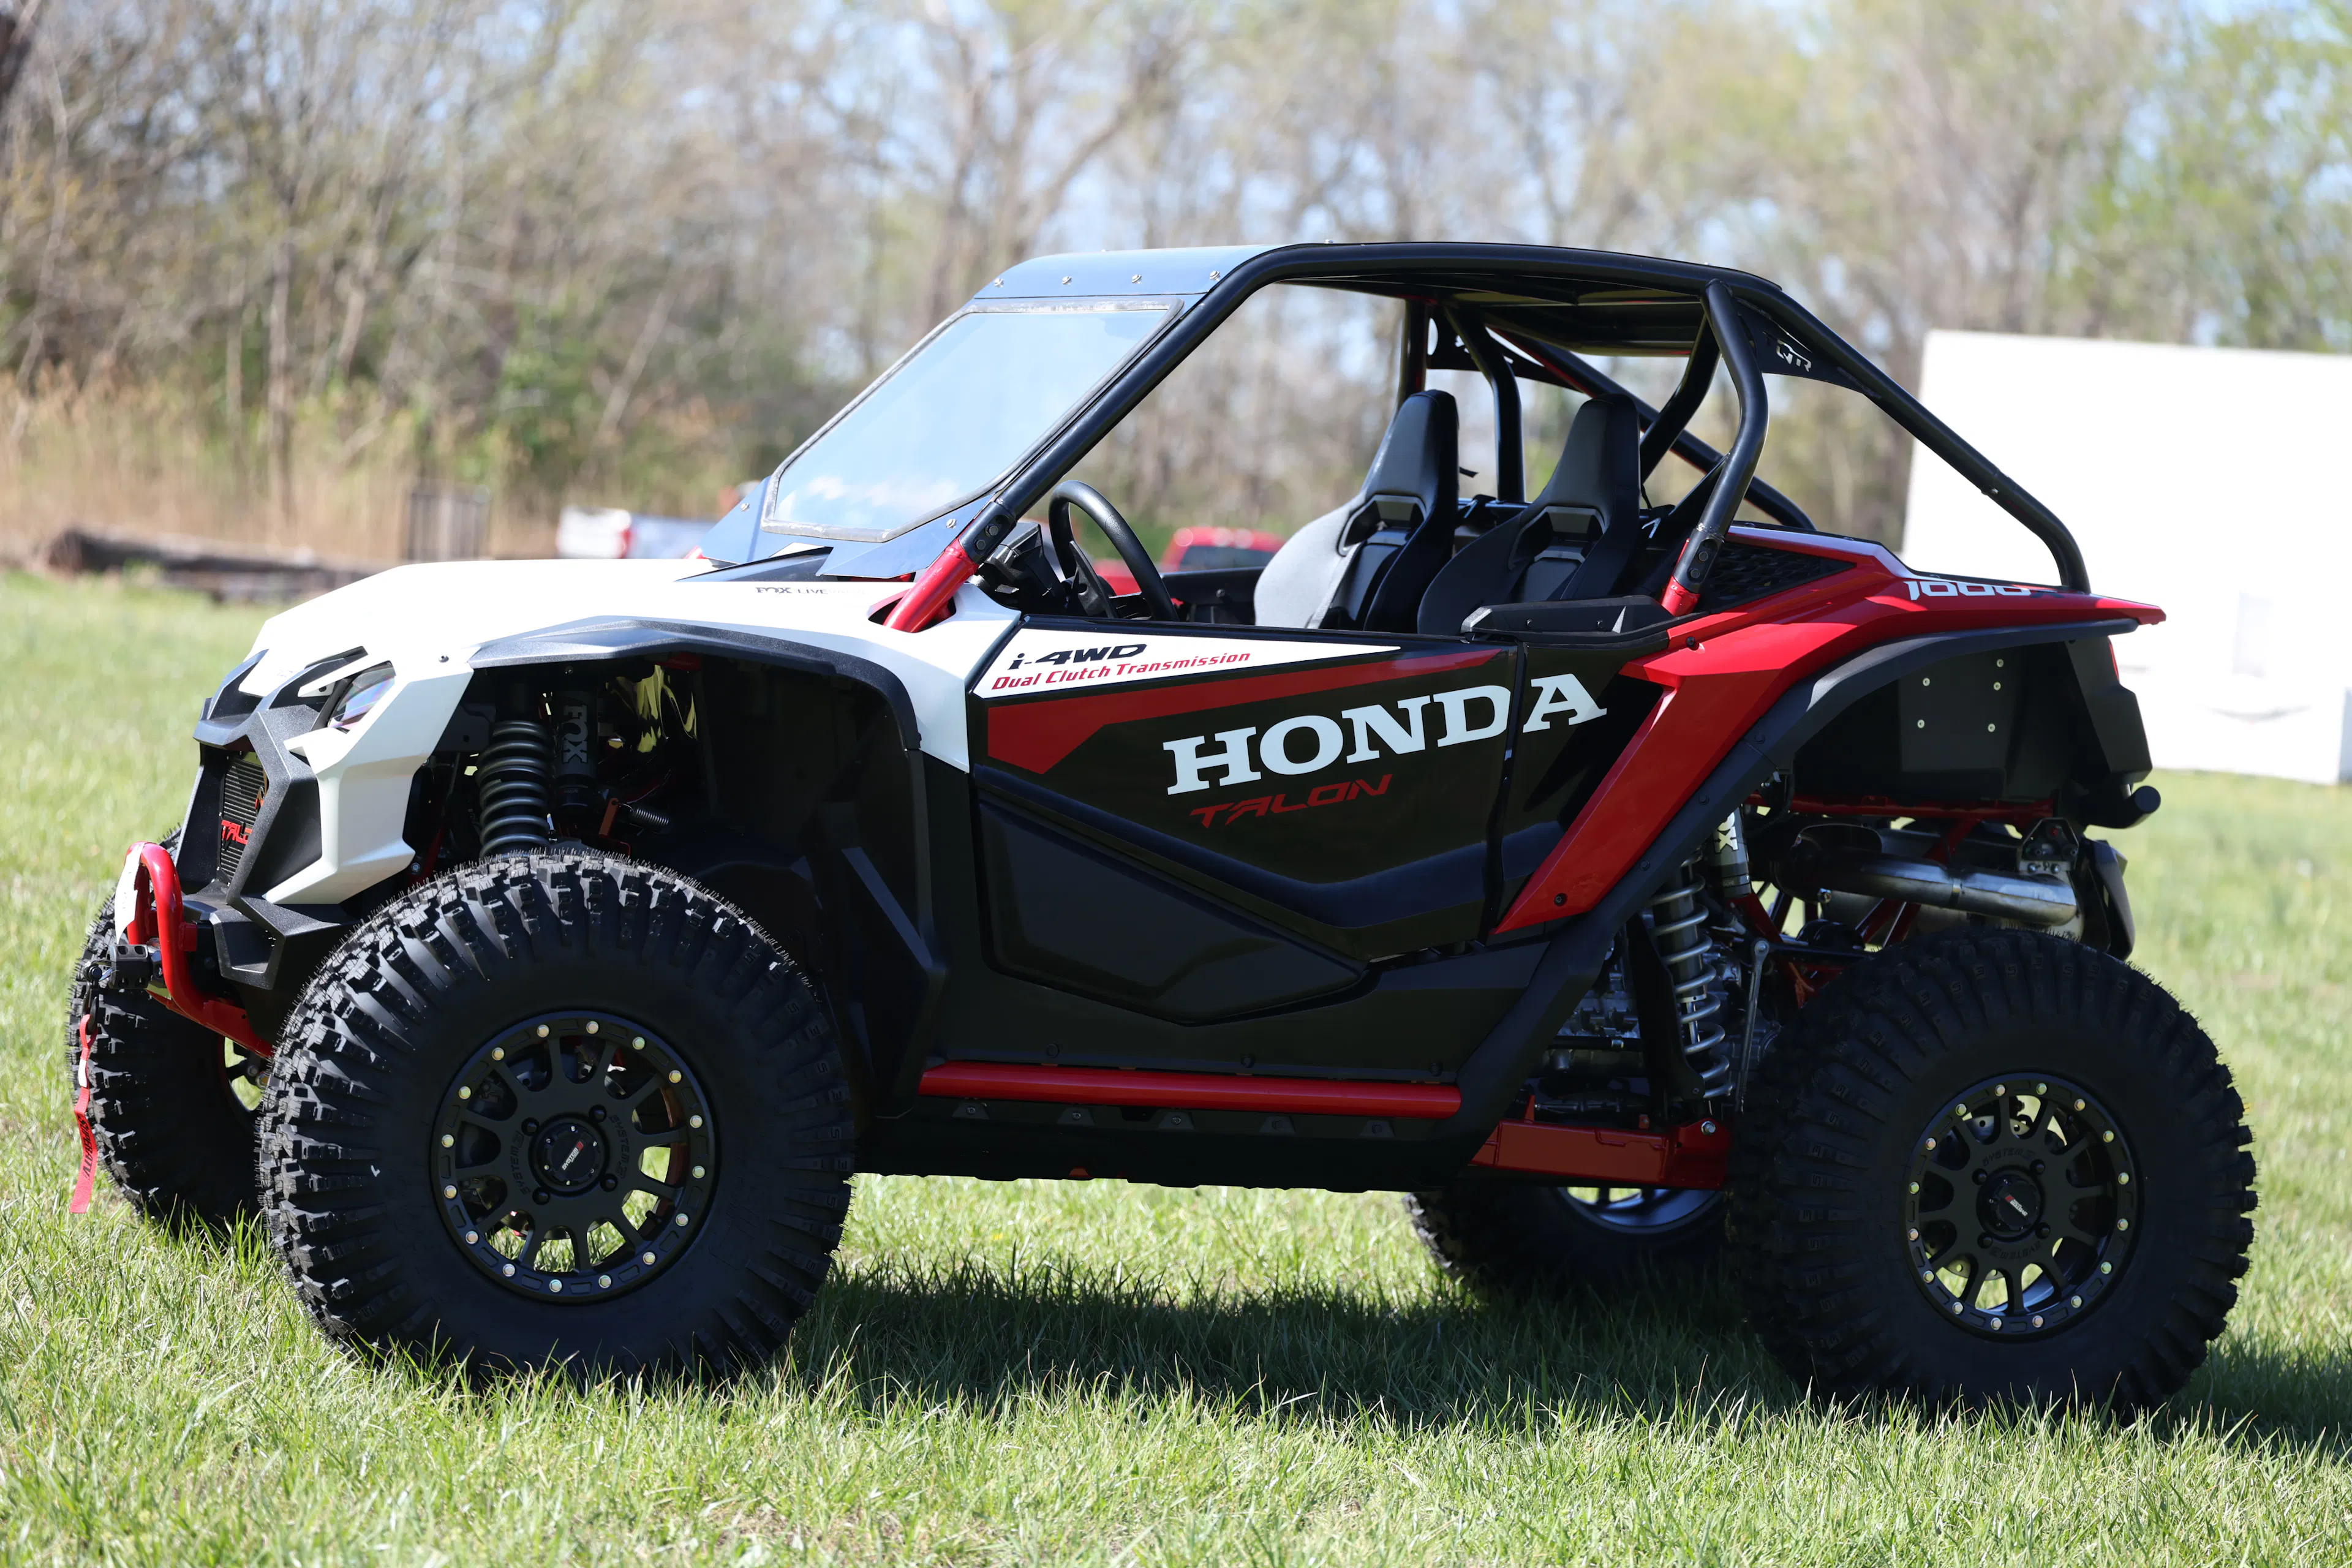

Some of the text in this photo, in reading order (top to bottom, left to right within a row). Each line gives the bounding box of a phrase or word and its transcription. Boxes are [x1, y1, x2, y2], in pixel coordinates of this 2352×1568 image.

[992, 652, 1251, 690] Dual Clutch Transmission
[1008, 644, 1147, 670] i-4WD
[563, 704, 588, 764] FOX
[1162, 673, 1608, 796] HONDA
[1189, 774, 1393, 829] TALON
